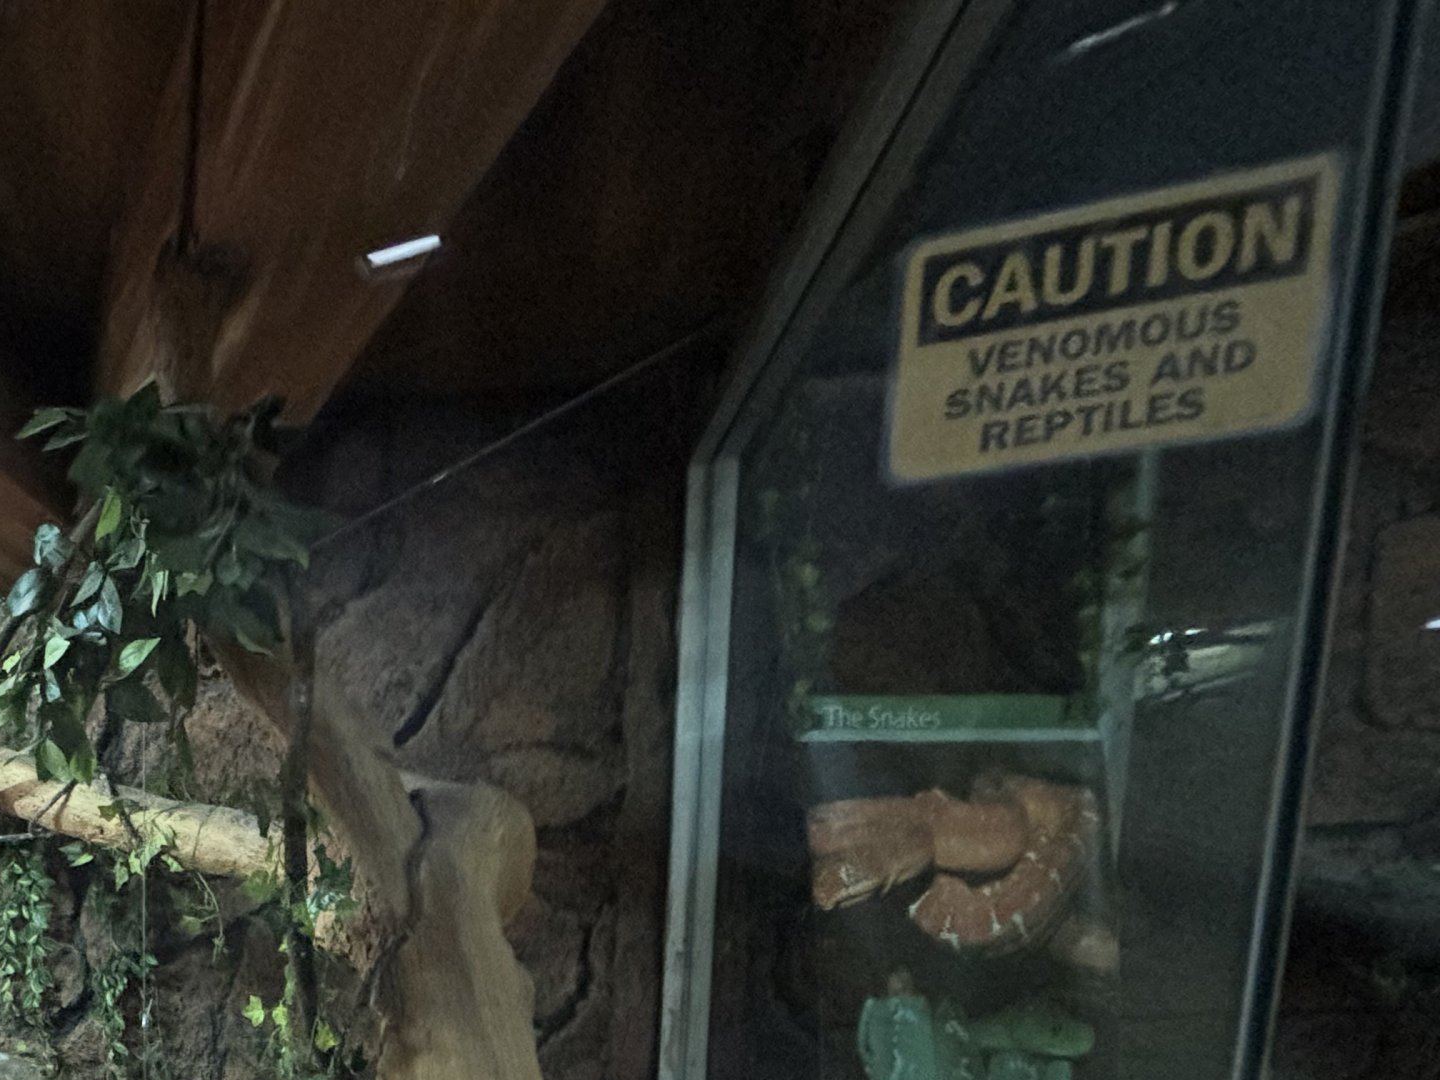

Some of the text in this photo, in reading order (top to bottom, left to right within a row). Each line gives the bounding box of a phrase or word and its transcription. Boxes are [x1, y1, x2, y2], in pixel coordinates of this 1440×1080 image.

[933, 201, 1300, 327] CAUTION
[968, 301, 1241, 378] VENOMOUS
[944, 339, 1257, 420] SNAKES AND
[978, 387, 1205, 453] REPTILES
[820, 704, 941, 729] The Snakes
